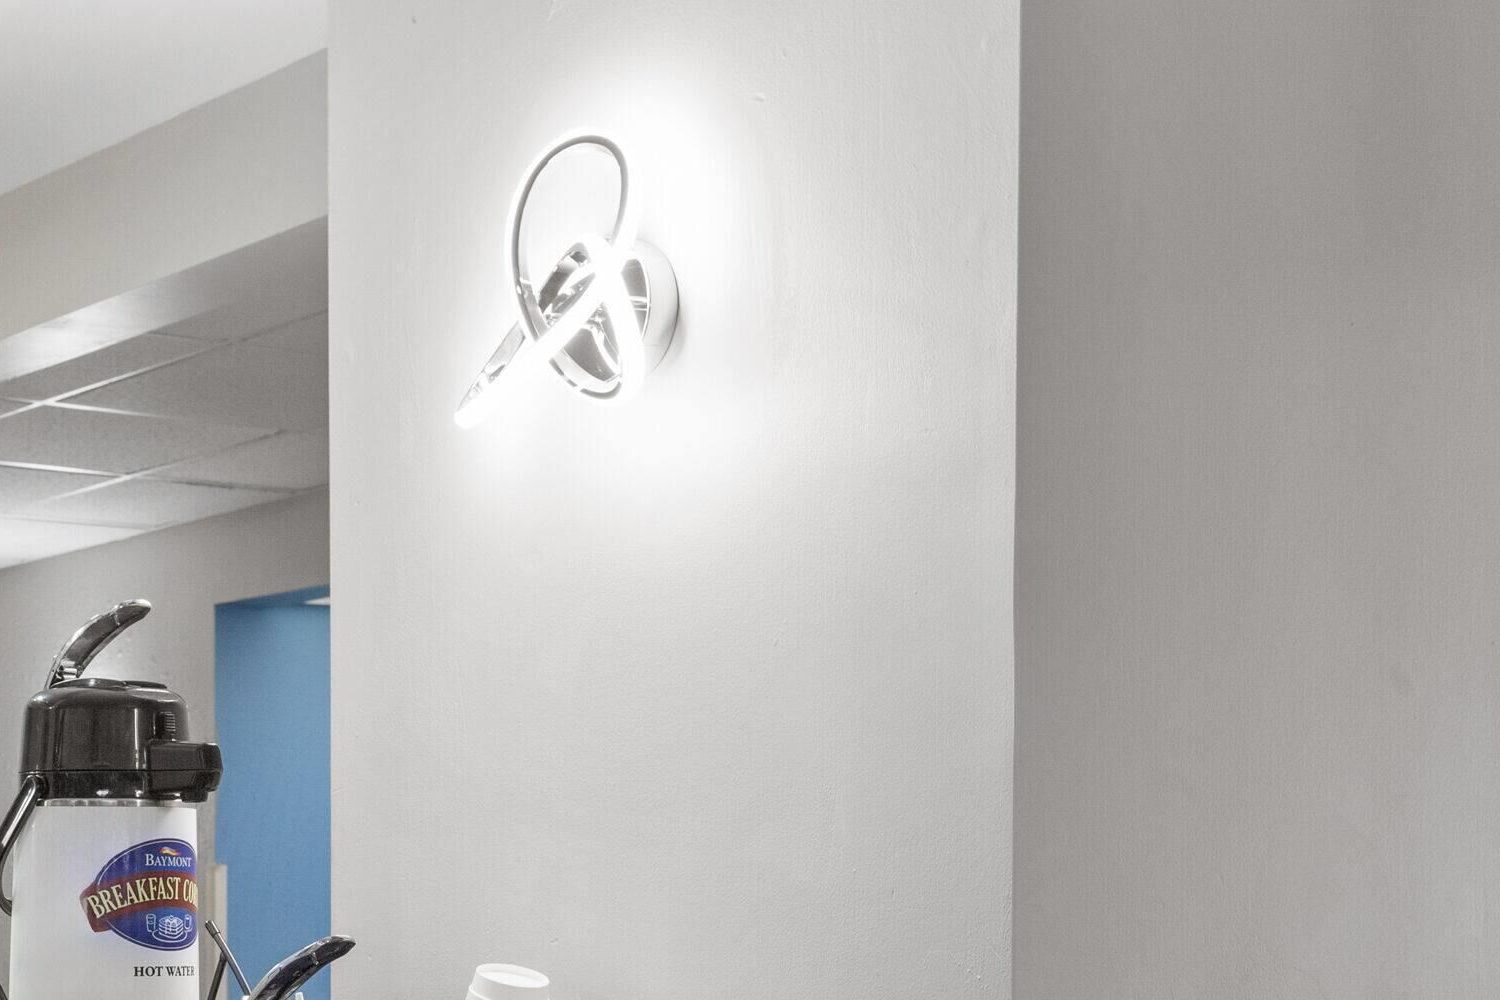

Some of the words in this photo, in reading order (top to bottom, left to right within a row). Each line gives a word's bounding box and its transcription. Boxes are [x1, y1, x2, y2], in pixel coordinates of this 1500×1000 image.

[145, 853, 192, 868] BAYMONT
[87, 876, 181, 919] BREAKFAST
[133, 966, 163, 977] HOT
[166, 965, 195, 977] WATER
